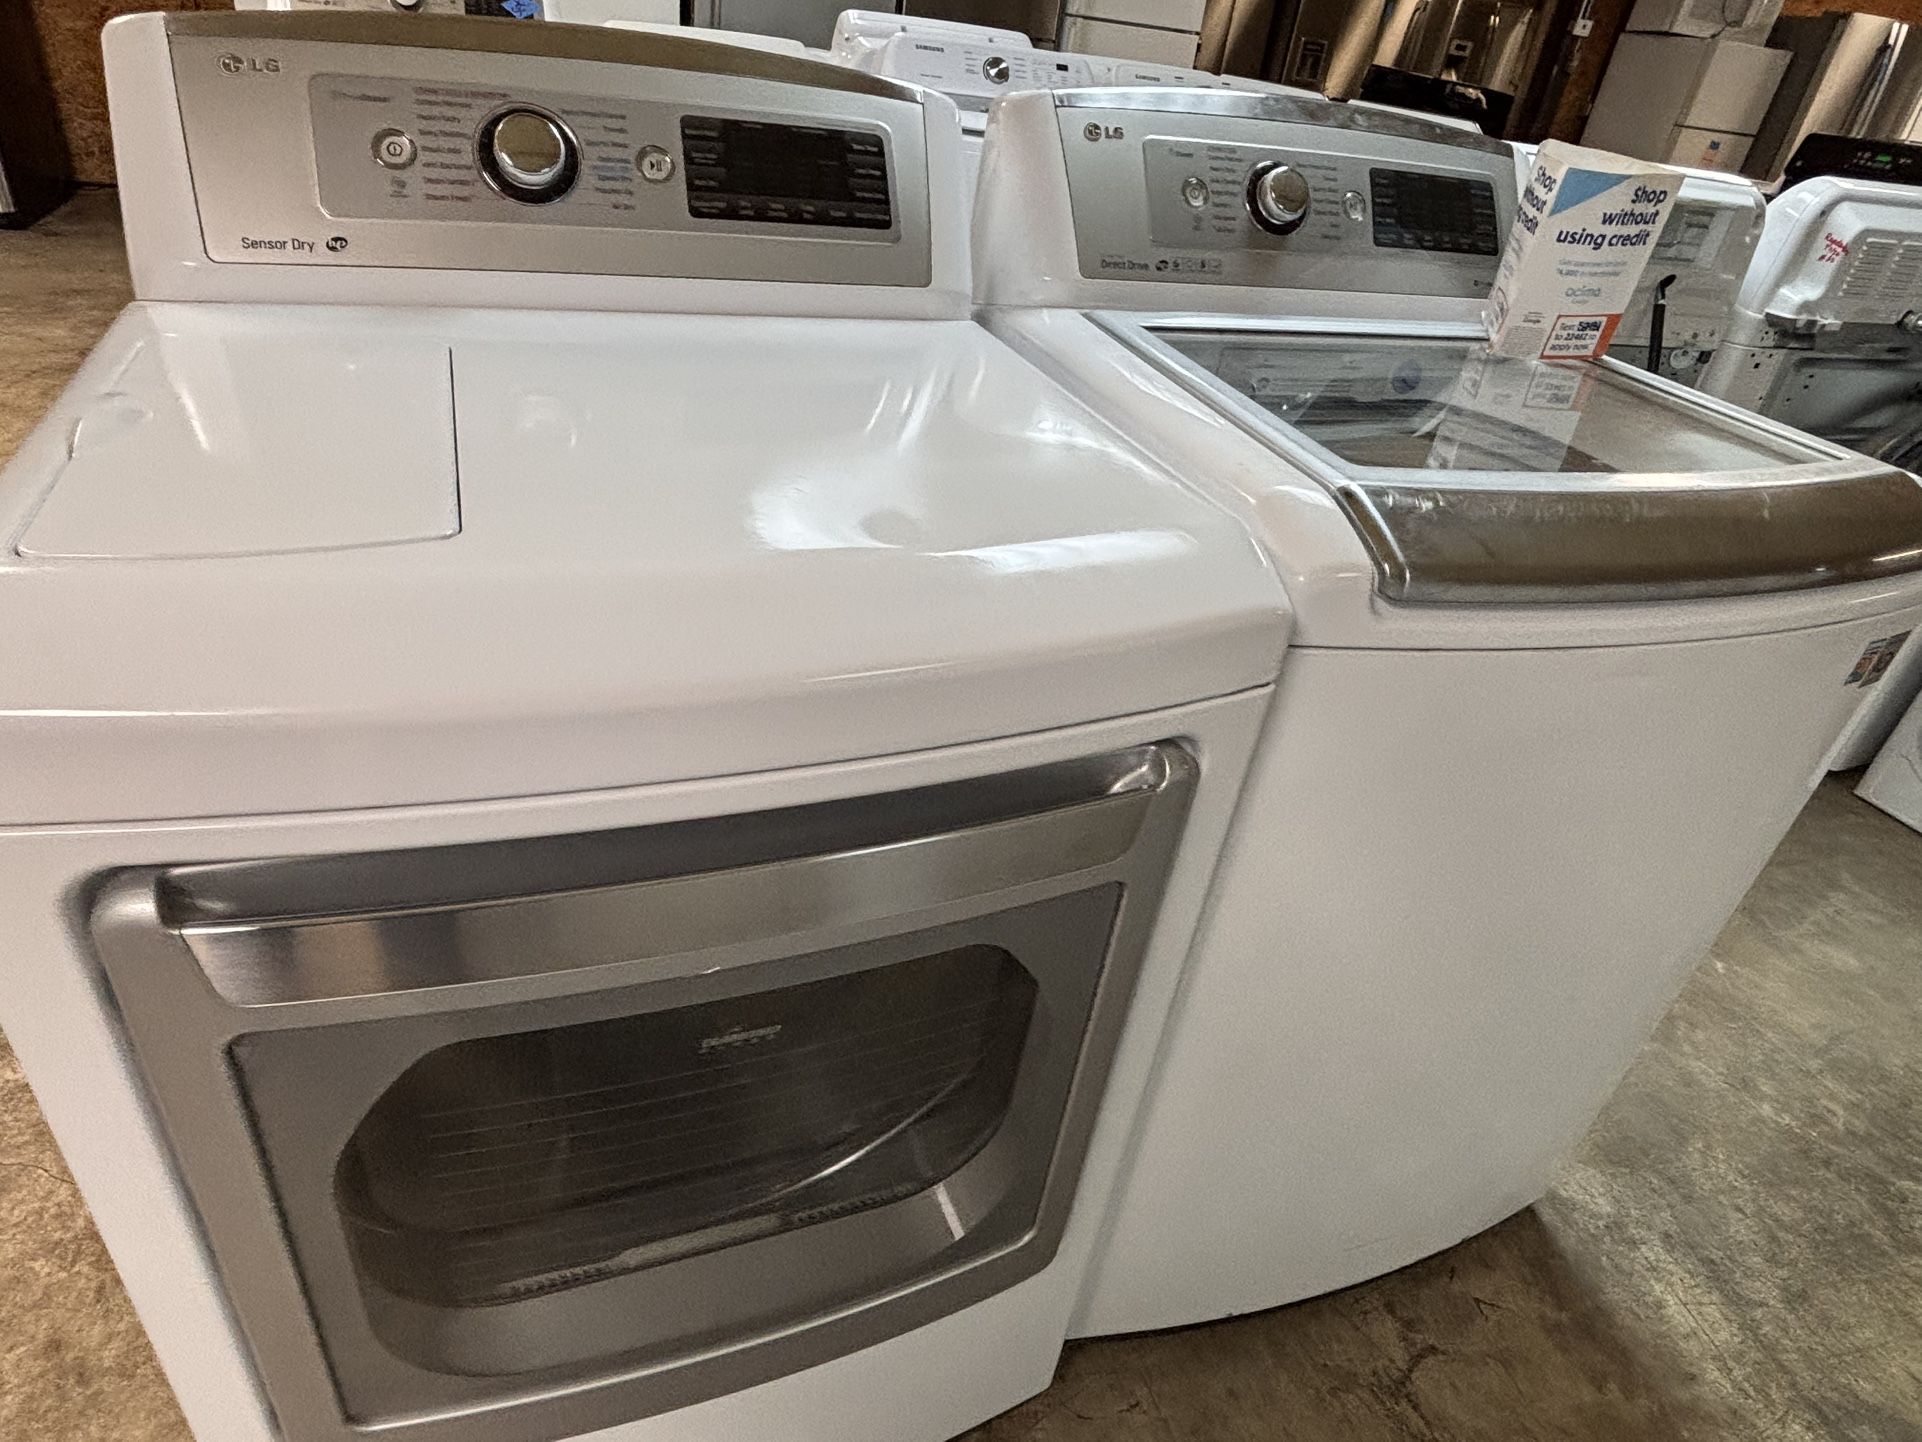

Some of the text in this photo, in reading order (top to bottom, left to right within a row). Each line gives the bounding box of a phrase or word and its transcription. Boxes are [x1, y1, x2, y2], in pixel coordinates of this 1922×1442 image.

[915, 44, 945, 53] SAMSUNG
[1631, 185, 1668, 207] Shop
[1601, 208, 1659, 226] without
[241, 236, 288, 250] Sensor
[291, 238, 315, 253] Dry
[1556, 227, 1651, 251] using credit
[1101, 259, 1126, 270] Direct
[1127, 260, 1149, 271] Drive
